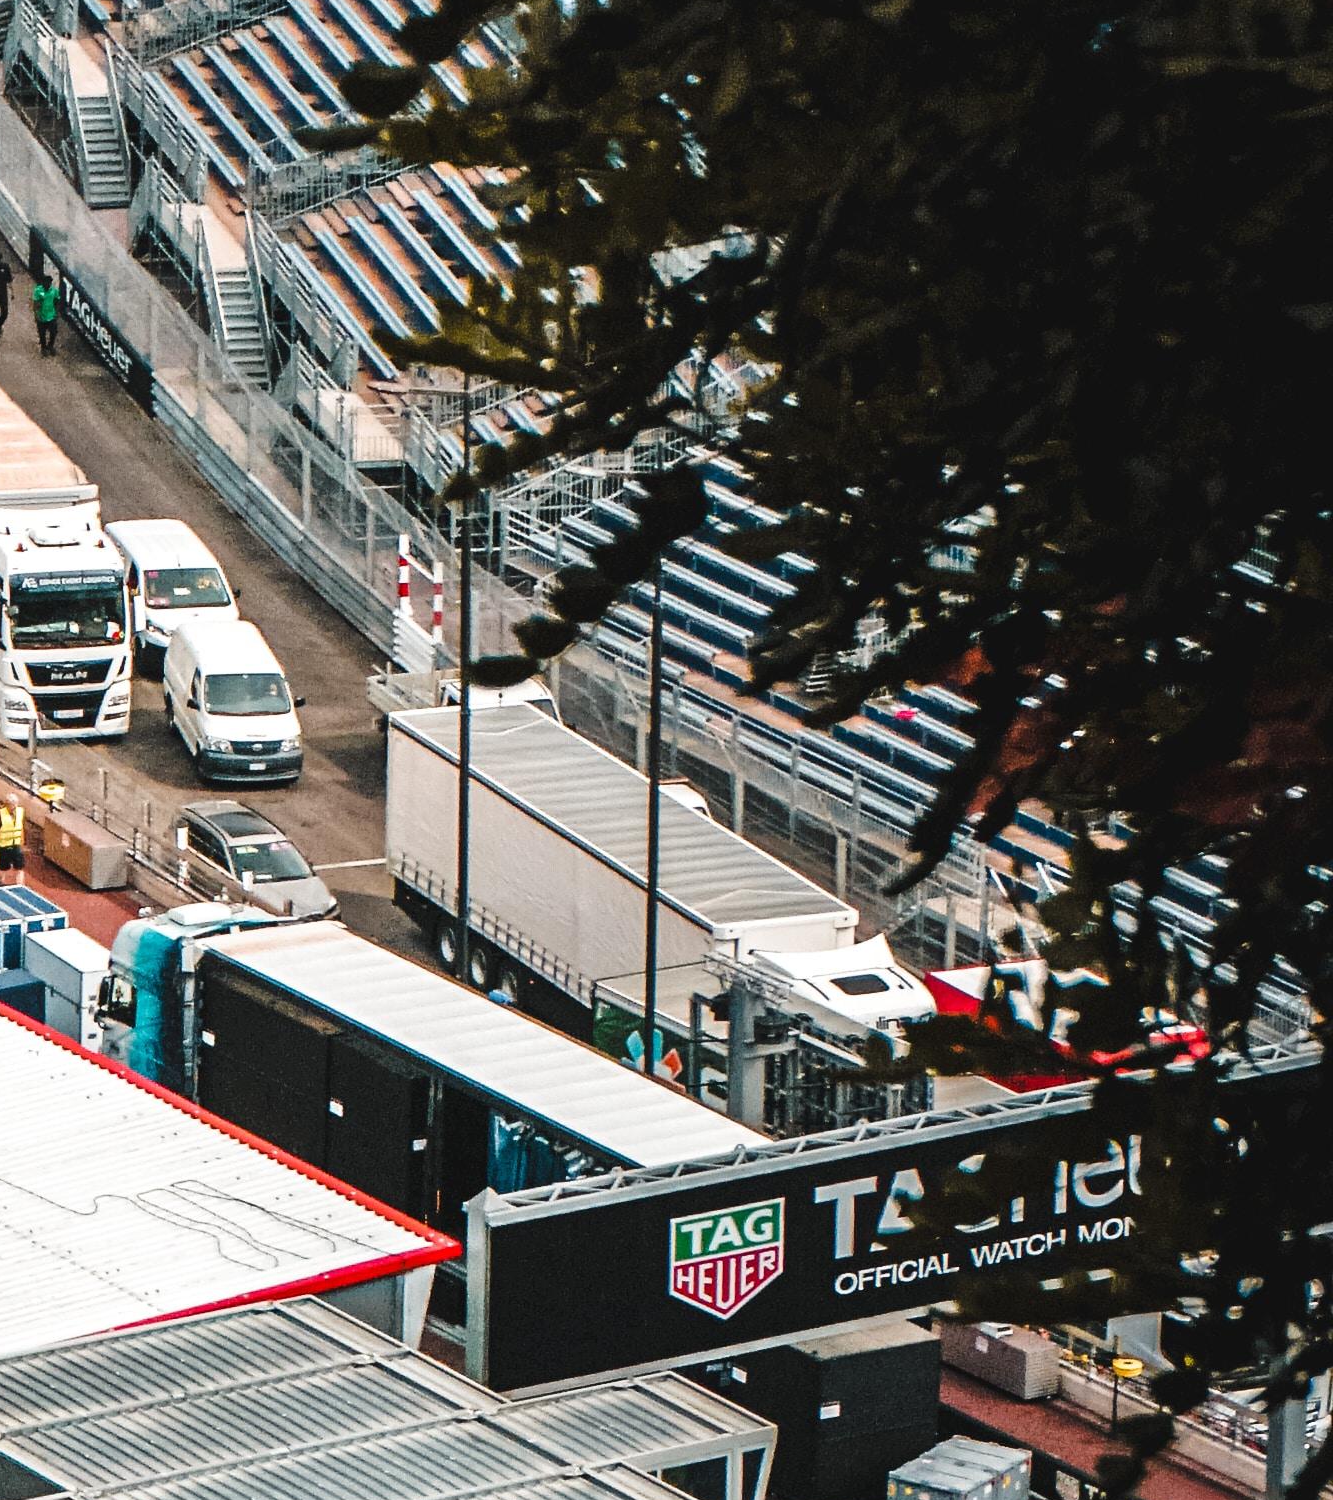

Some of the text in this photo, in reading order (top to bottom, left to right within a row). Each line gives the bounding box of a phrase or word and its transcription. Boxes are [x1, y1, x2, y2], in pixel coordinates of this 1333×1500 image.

[681, 1206, 775, 1256] TAG
[675, 1251, 777, 1311] HEUER
[834, 1252, 960, 1296] OFFICIAL
[971, 1228, 1067, 1269] WATCH
